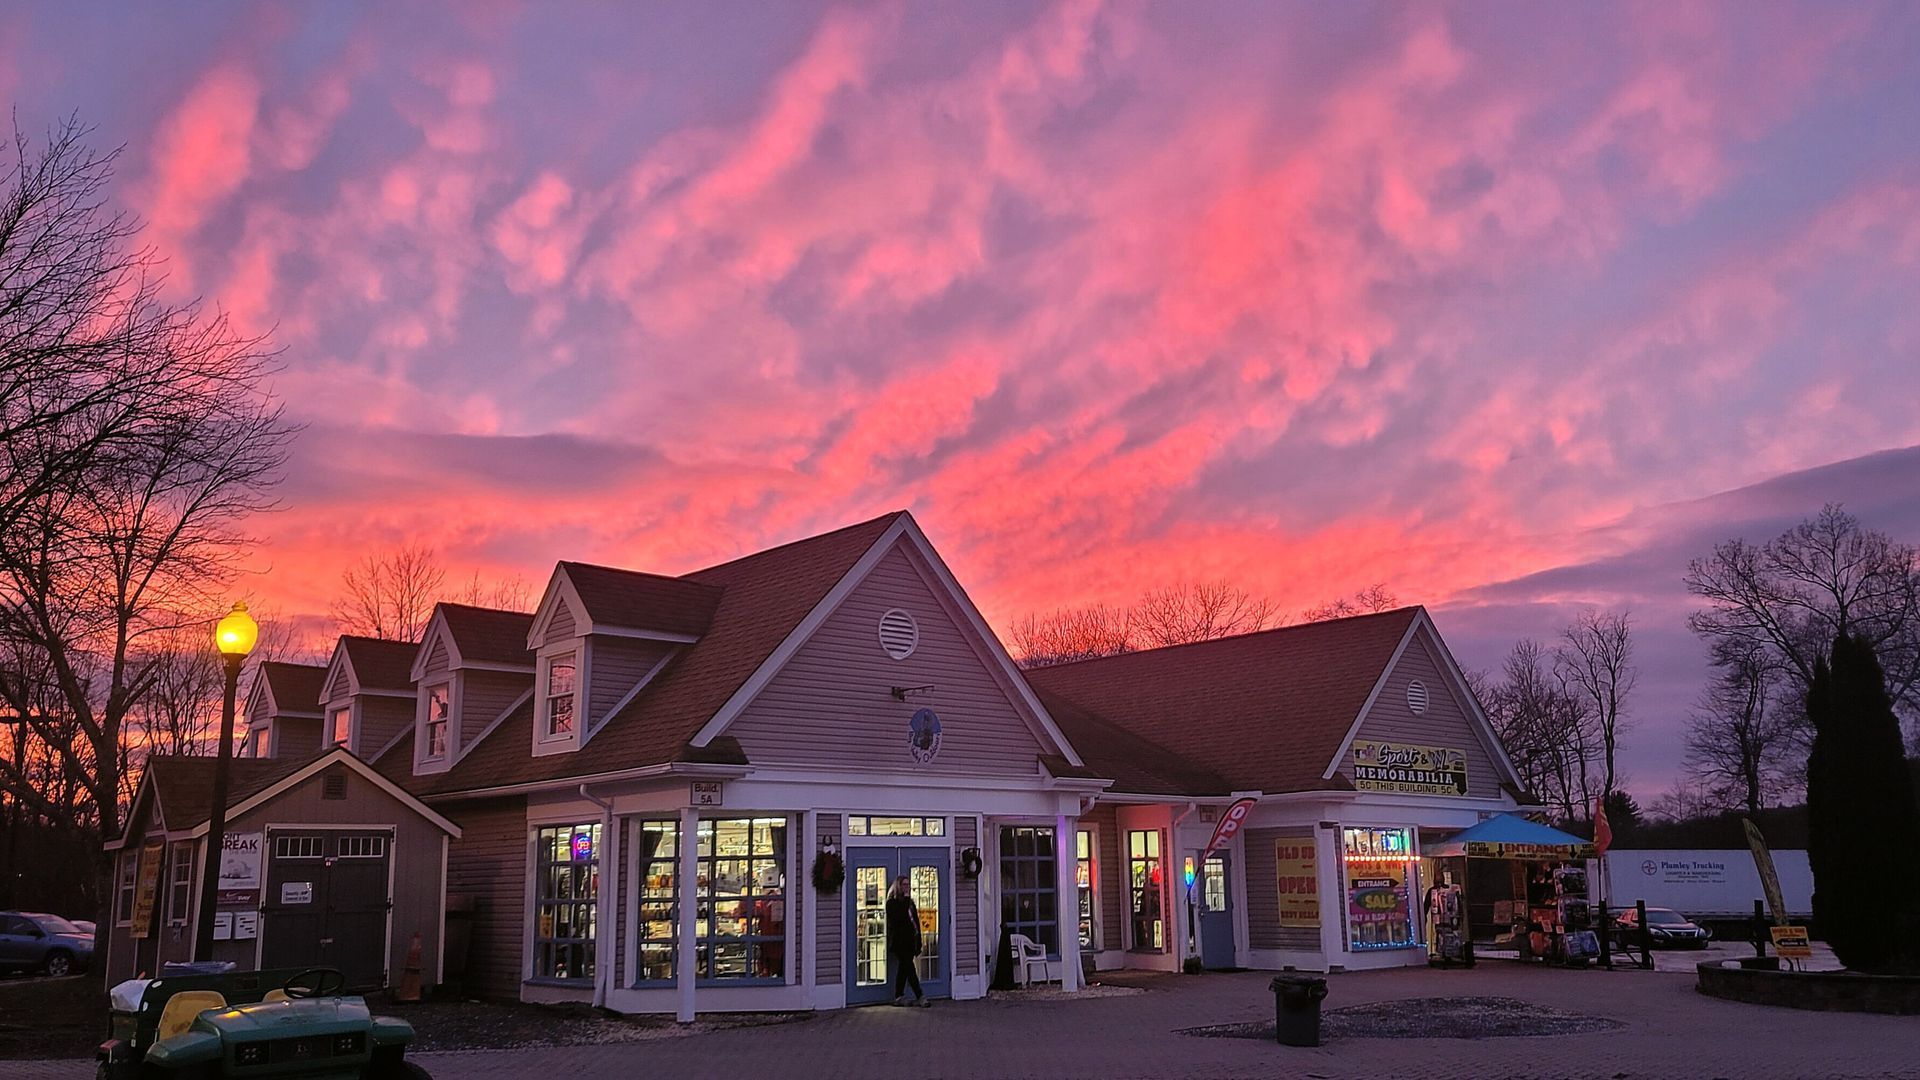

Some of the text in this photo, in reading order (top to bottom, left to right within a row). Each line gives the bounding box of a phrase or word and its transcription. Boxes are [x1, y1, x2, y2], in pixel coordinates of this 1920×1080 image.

[1377, 743, 1420, 769] Sport
[1421, 754, 1429, 764] &
[1355, 766, 1453, 784] MEMORABILIA
[695, 783, 719, 792] Build.
[1360, 781, 1452, 794] 5C THIS BUILDING 5C
[701, 794, 712, 803] 5A
[222, 839, 258, 850] REAK
[1504, 844, 1569, 854] ENTRANCE
[1661, 861, 1724, 870] Plumley Trucking
[1279, 876, 1317, 894] OPEN
[1357, 880, 1391, 888] ENTRANCE
[1365, 894, 1396, 909] SALE
